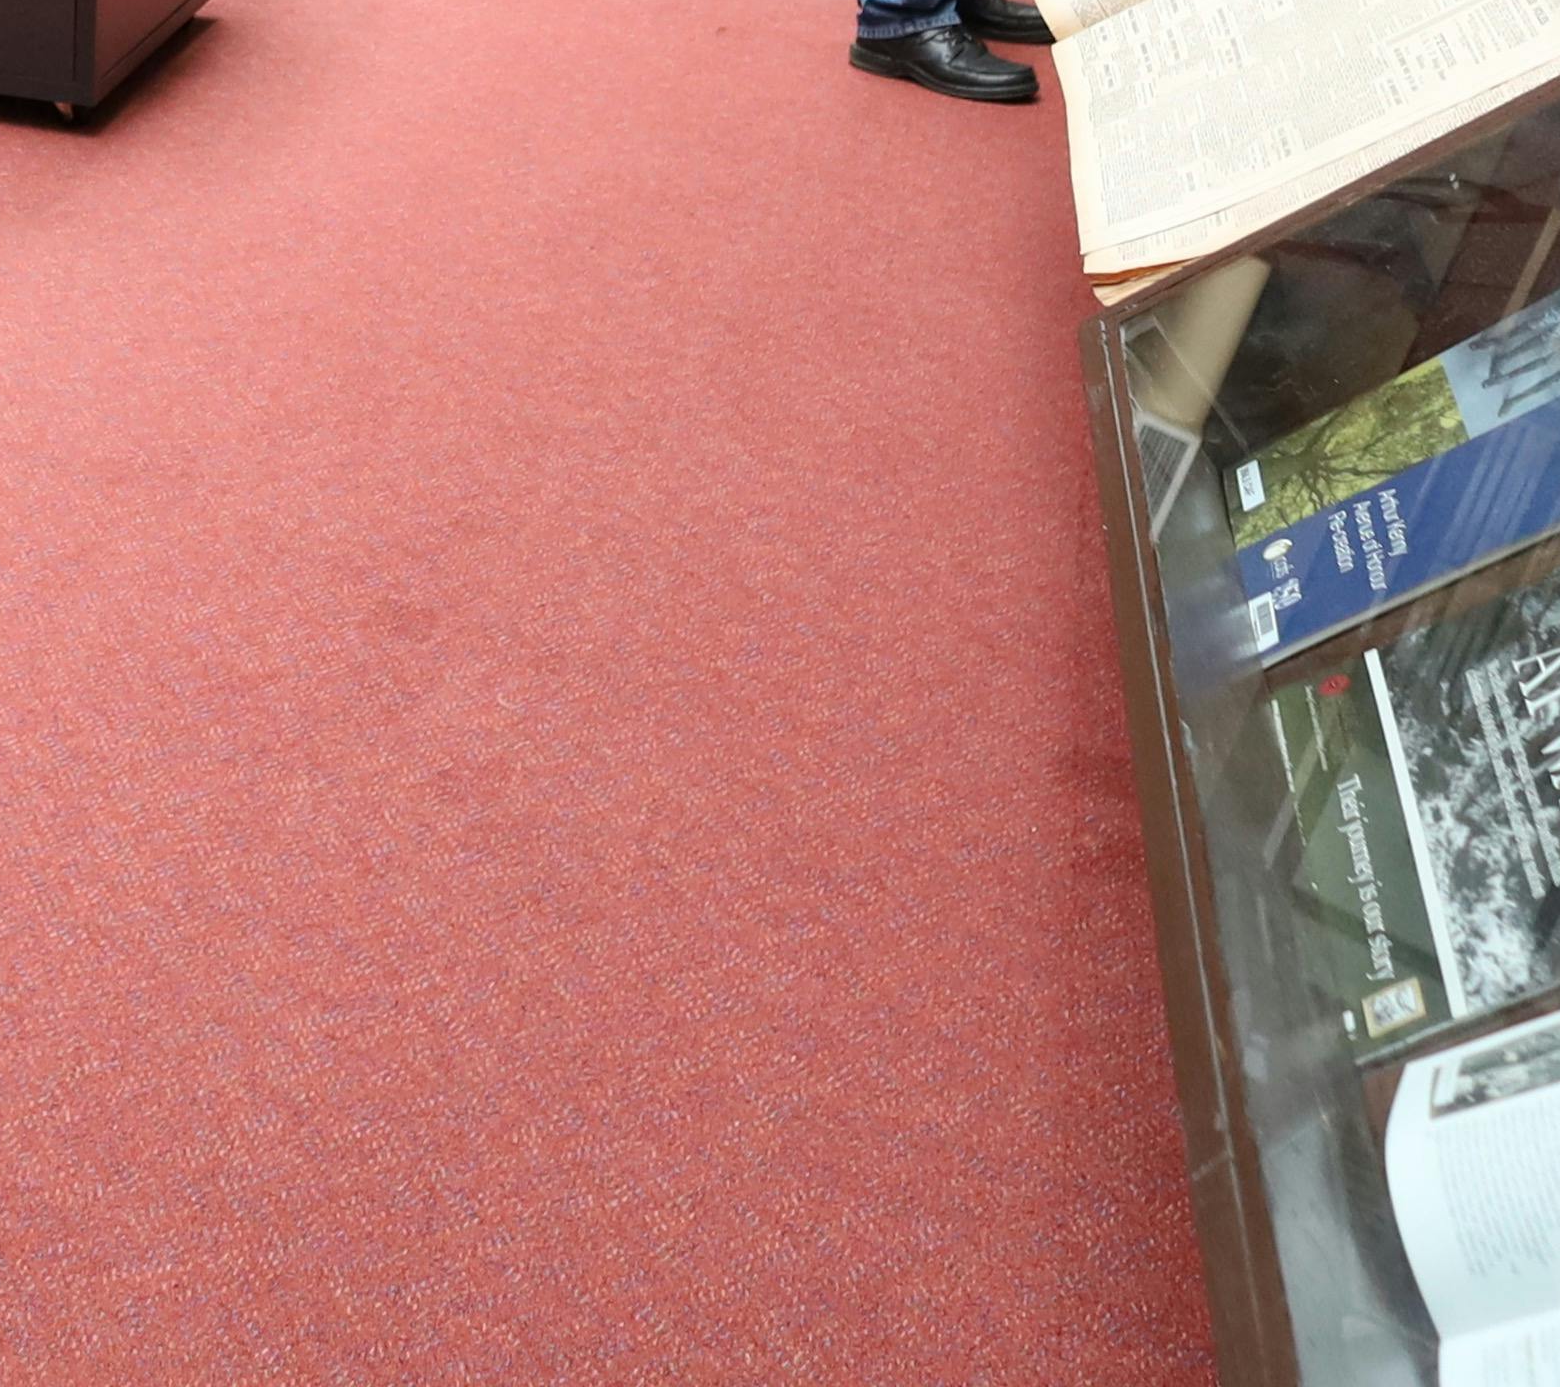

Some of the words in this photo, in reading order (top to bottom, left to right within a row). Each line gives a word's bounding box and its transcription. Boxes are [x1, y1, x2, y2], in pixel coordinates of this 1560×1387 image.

[1352, 499, 1379, 542] Avenue
[1376, 487, 1402, 524] Arthur
[1327, 510, 1357, 573] Re-creation
[1360, 536, 1383, 554] of
[1385, 520, 1410, 558] Kenny
[1363, 549, 1391, 592] Honour
[1332, 772, 1369, 821] Their
[1333, 817, 1381, 885] journey
[1355, 880, 1385, 904] is
[1358, 900, 1387, 934] our
[1357, 932, 1401, 985] story
